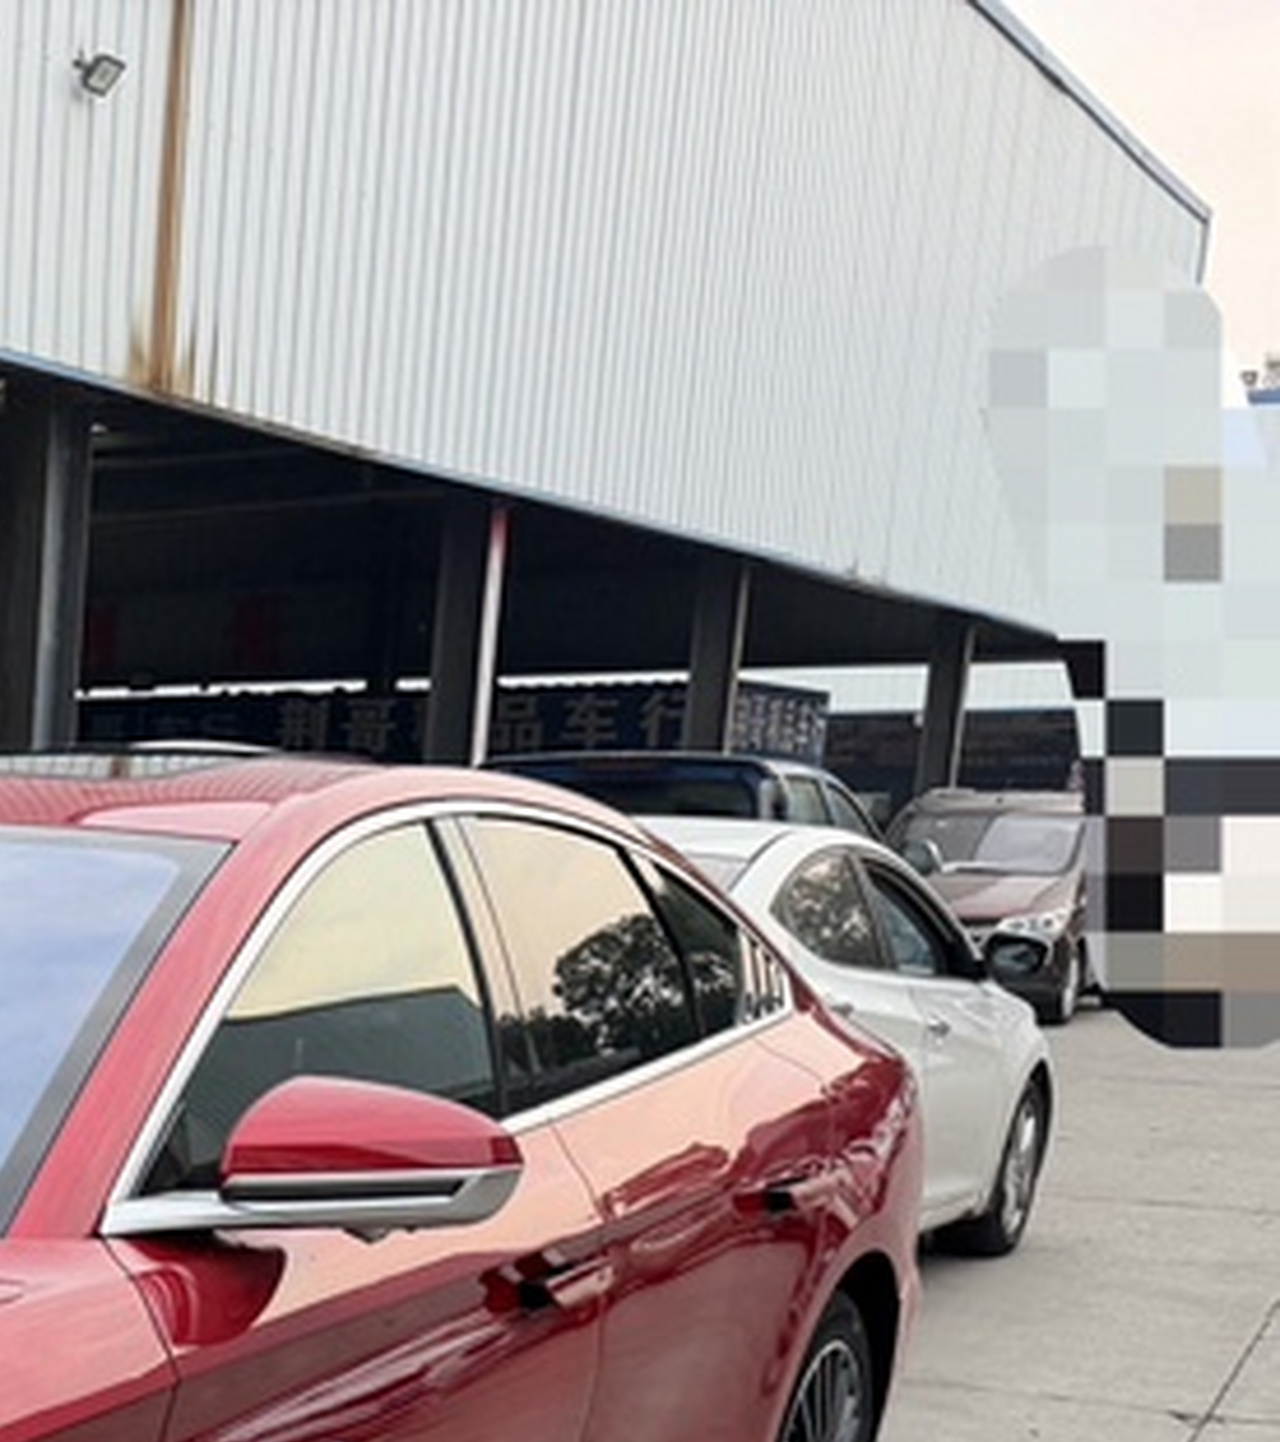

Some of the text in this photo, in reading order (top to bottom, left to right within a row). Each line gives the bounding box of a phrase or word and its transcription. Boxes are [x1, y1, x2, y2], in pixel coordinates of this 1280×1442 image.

[274, 689, 685, 753] 荆哥品车行
